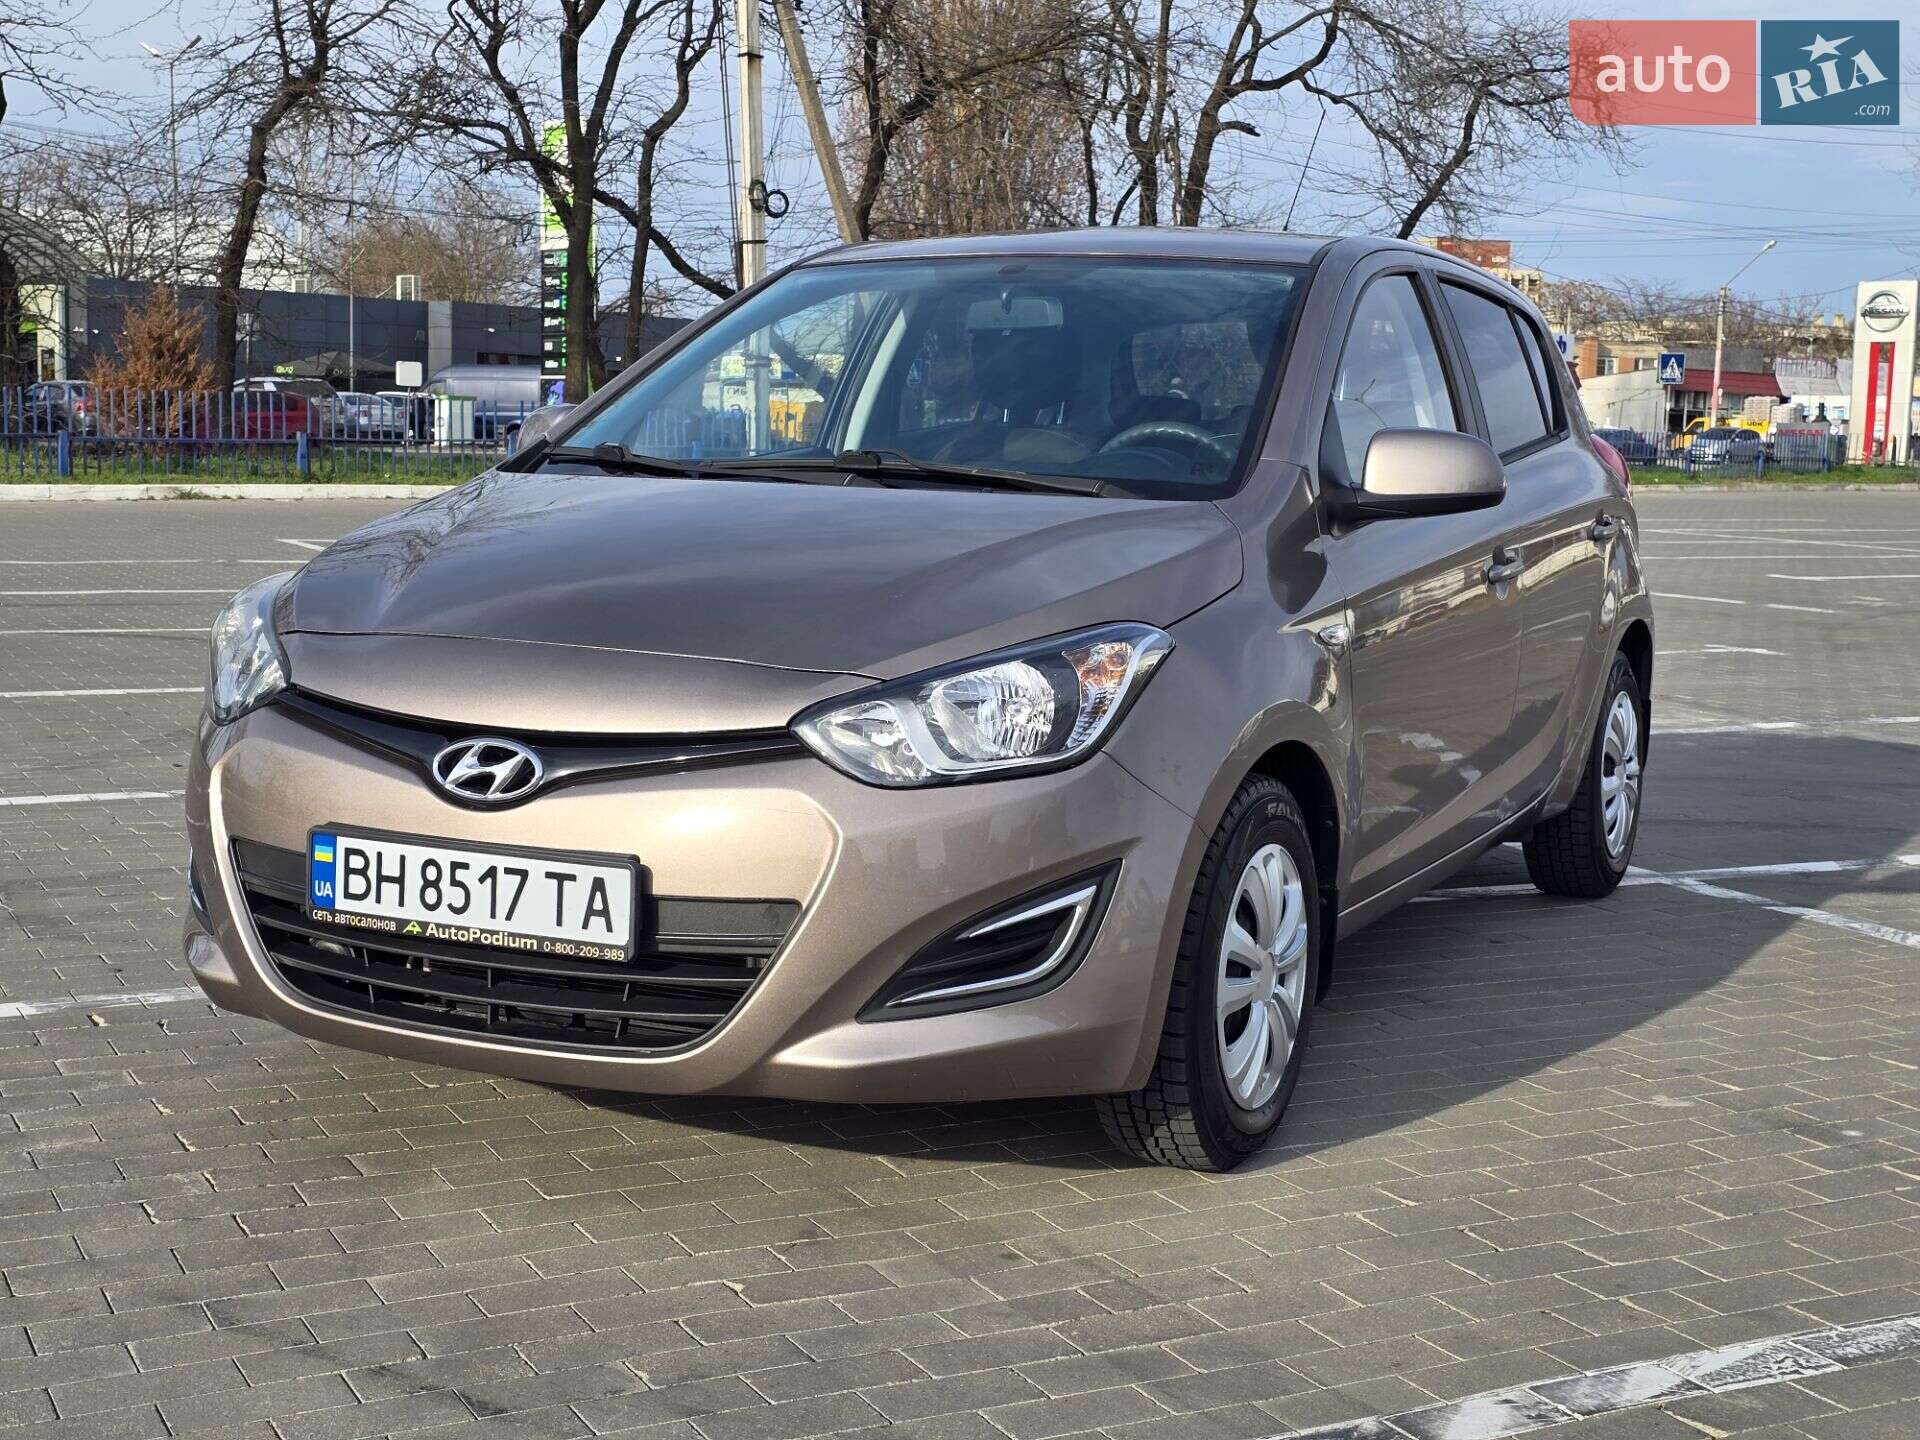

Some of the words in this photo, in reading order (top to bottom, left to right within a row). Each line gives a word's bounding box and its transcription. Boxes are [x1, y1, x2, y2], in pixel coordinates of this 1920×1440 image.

[1864, 307, 1904, 317] NISSAN
[314, 880, 334, 898] UA
[343, 846, 406, 908] BH
[418, 858, 529, 921] 8517
[545, 871, 613, 933] TA
[312, 909, 333, 922] сеть
[334, 912, 397, 931] автосалонов
[425, 922, 538, 950] AutoPodium
[543, 941, 625, 961] 0-800-209-989
